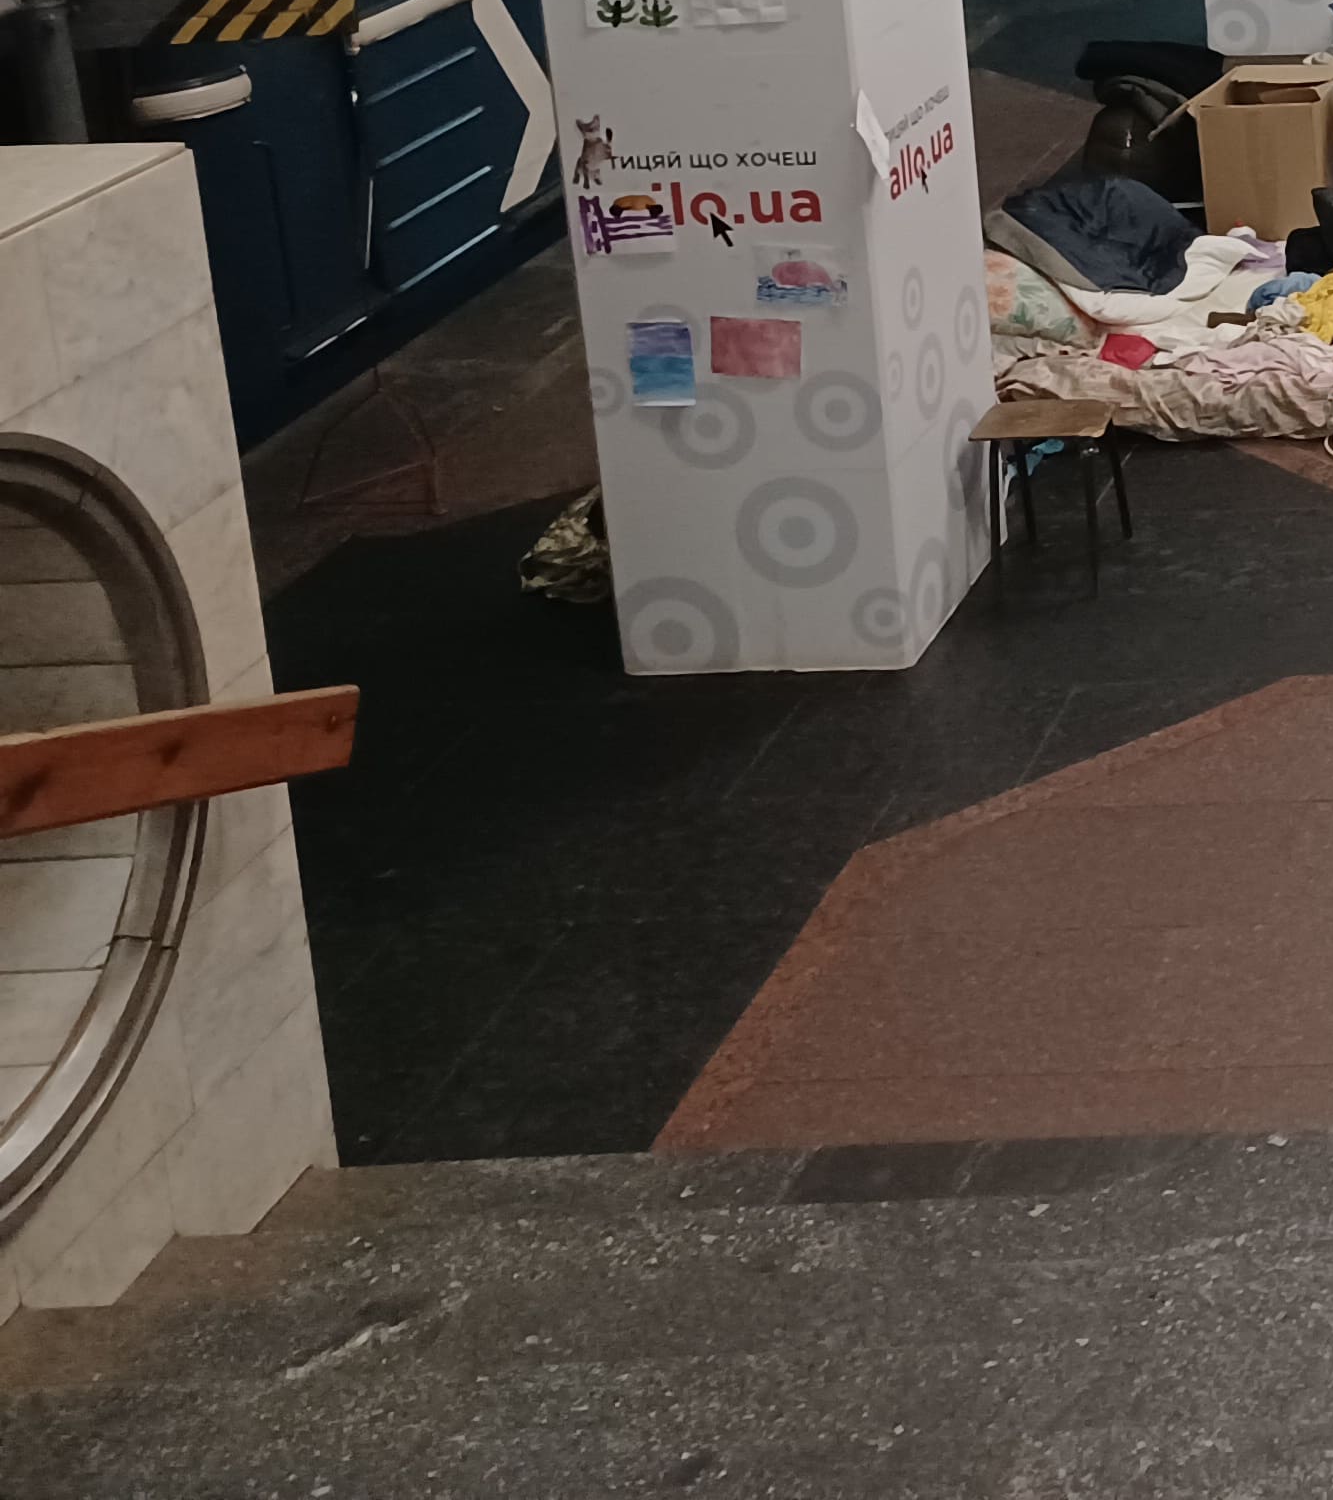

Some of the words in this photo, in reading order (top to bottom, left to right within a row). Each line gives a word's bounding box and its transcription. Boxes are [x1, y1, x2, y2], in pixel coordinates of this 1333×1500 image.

[609, 151, 682, 171] ТИЦЯЙ
[689, 152, 728, 170] ЩО
[736, 151, 817, 167] ХОЧЕШ
[889, 122, 954, 201] allo.ua
